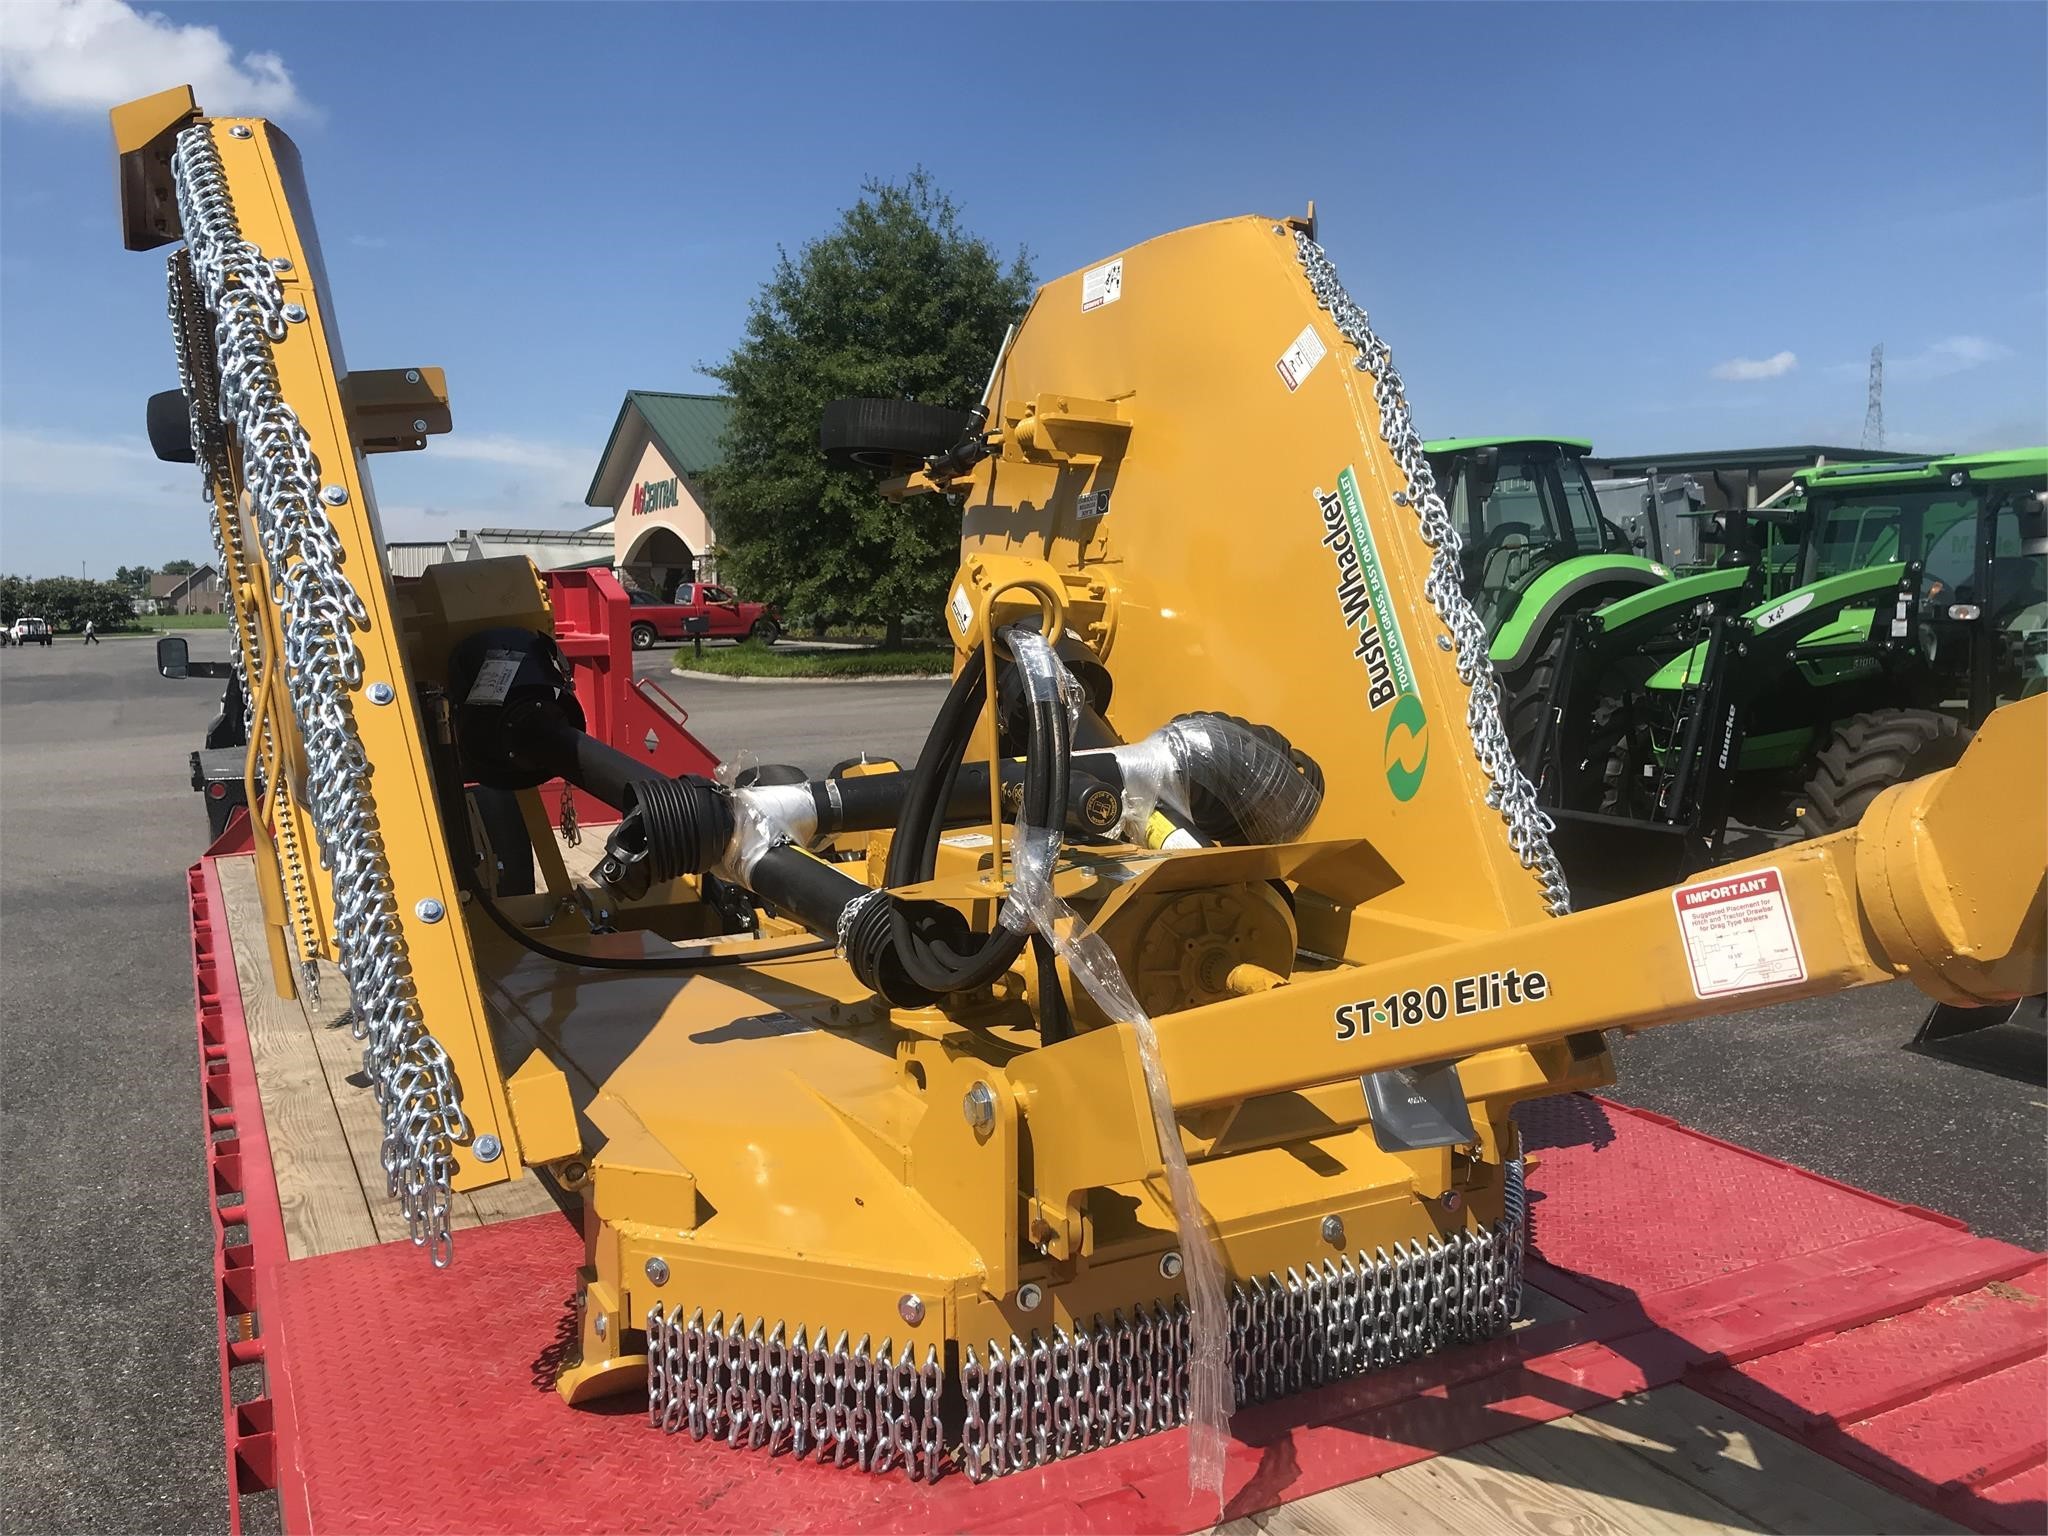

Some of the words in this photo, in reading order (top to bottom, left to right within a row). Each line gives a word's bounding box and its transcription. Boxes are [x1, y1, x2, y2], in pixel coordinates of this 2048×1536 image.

[1341, 476, 1358, 518] WALLET
[1352, 516, 1367, 547] YOUR
[1361, 545, 1372, 562] ON
[1366, 564, 1380, 592] EASY
[1386, 630, 1398, 649] ON
[1392, 649, 1410, 692] TOUGH
[1685, 878, 1768, 905] IMPORTANT
[1692, 908, 1725, 919] Suggested
[1726, 901, 1760, 912] Placement
[1710, 922, 1726, 930] Drag
[1726, 919, 1742, 927] Type
[1743, 914, 1769, 923] Mowers
[1723, 912, 1745, 920] Tractor
[1746, 905, 1774, 916] Drawbar
[1454, 969, 1548, 1015] Elite
